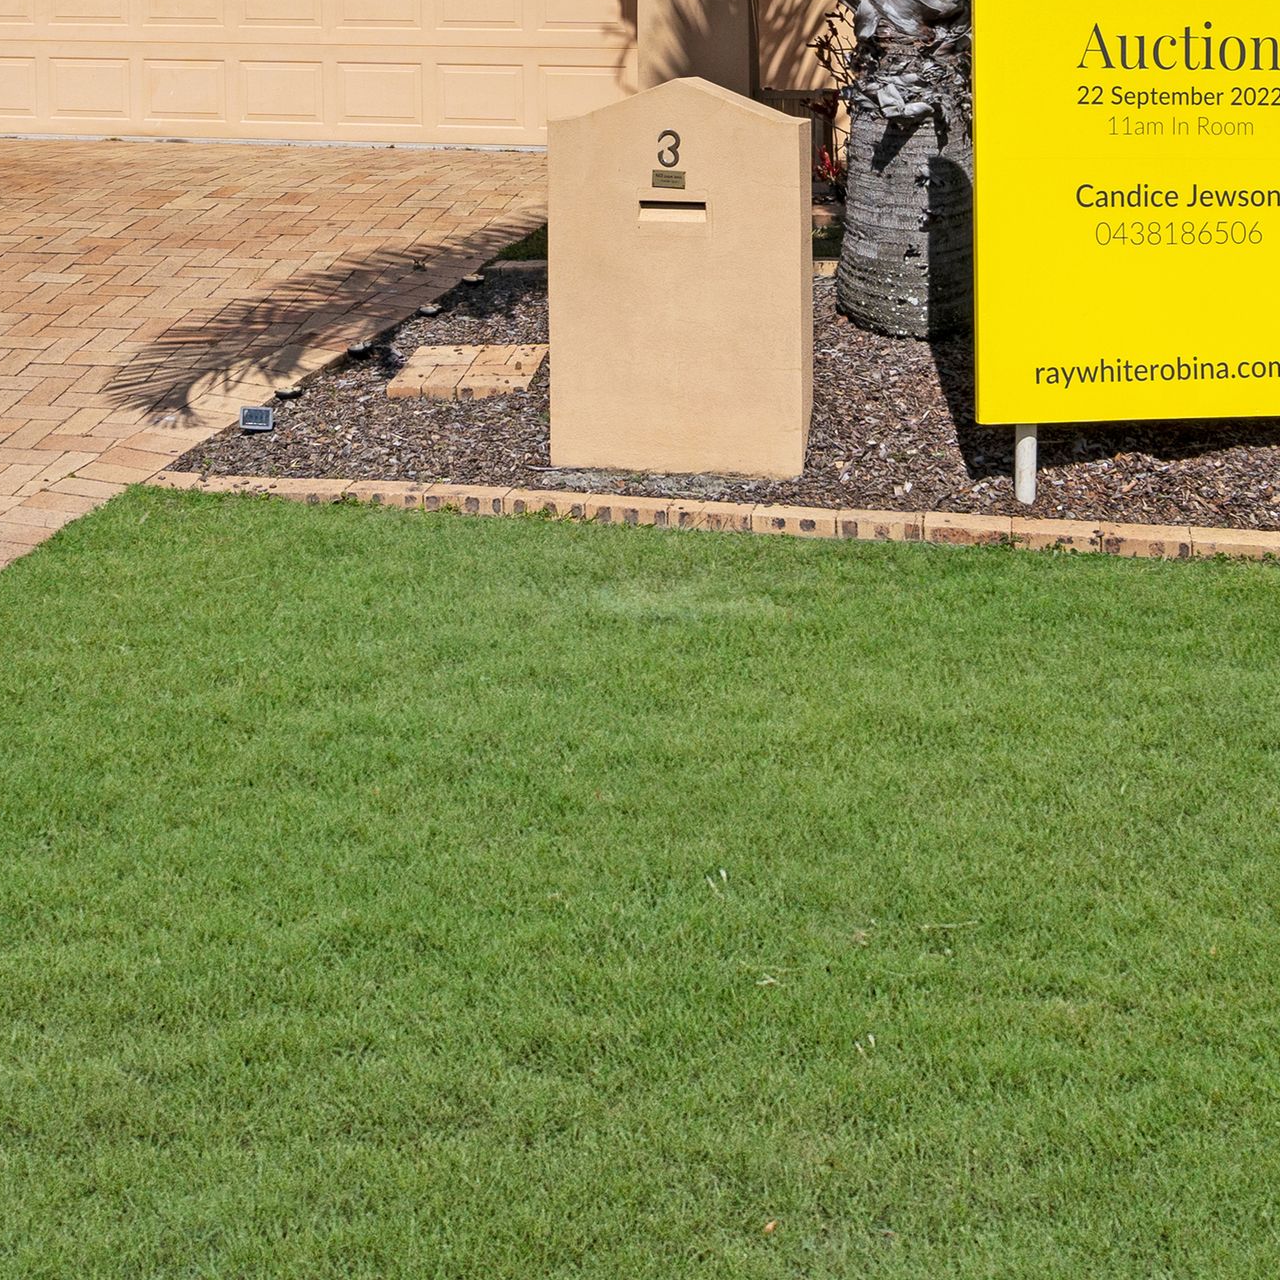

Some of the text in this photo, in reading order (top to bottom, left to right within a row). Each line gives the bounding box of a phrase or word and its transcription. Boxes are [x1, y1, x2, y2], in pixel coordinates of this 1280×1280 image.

[1076, 85, 1104, 106] 22
[1110, 85, 1225, 109] September
[1108, 116, 1254, 136] 11am In Room
[657, 129, 681, 168] 3
[1075, 183, 1179, 208] Candice
[1095, 220, 1263, 246] 0438186506
